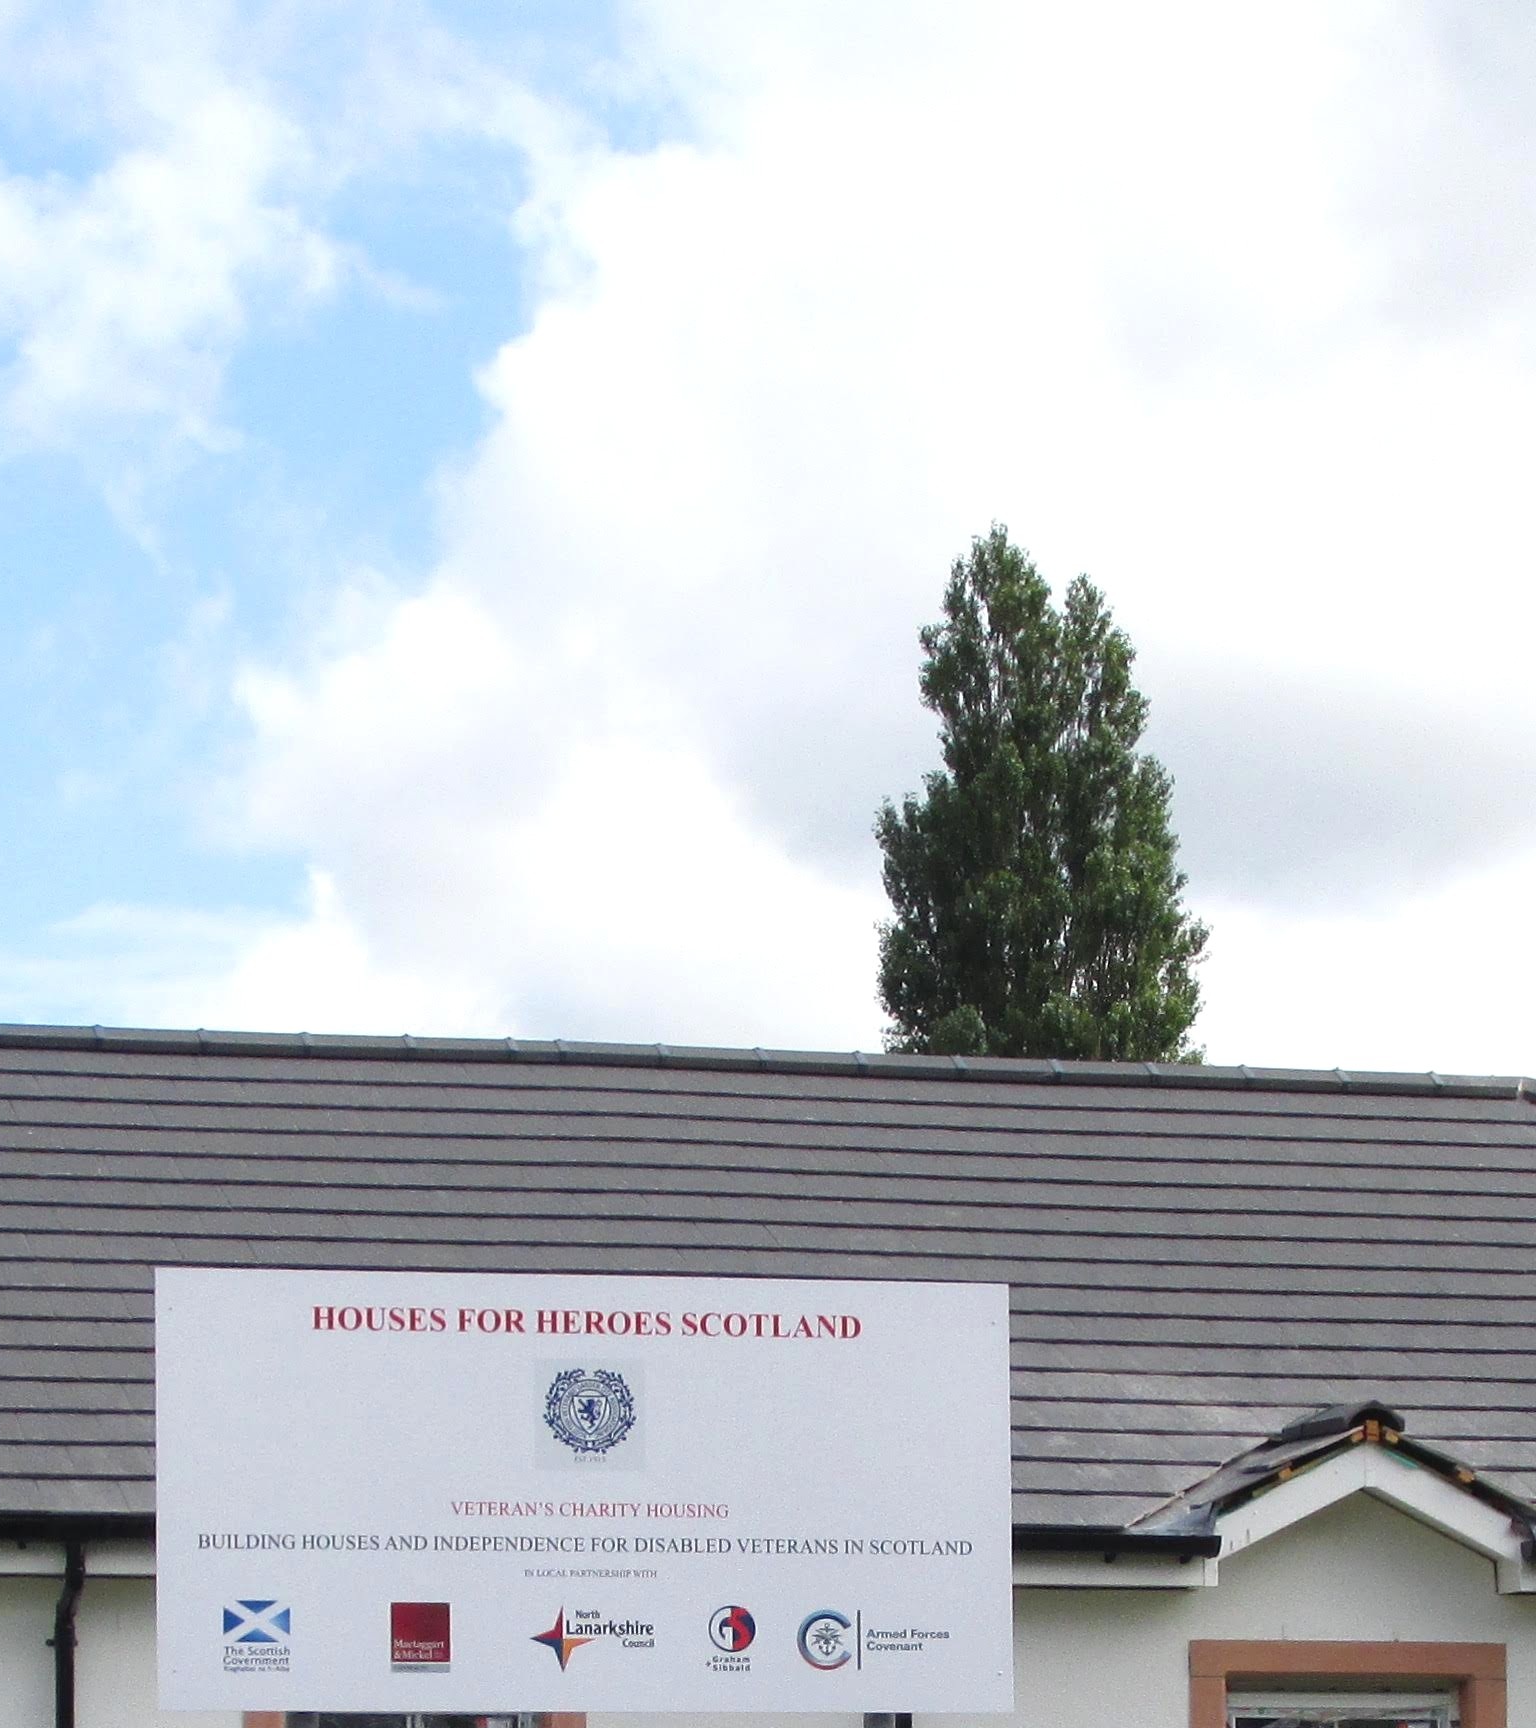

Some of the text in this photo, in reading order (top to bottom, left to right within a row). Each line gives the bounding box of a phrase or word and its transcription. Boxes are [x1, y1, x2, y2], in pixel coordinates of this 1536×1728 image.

[313, 1306, 862, 1339] HOUSES FOR HEROES SCOTLAND
[451, 1501, 729, 1518] VETERAN'S CHARITY HOUSING
[198, 1533, 973, 1556] BUILDING HOUSES AND INDEPENDENCE FOR DISABLED VETERANS IN SCOTLAND
[524, 1569, 657, 1578] IN LOCAL PARTNERSHIP WITH
[575, 1610, 600, 1619] North
[566, 1620, 654, 1638] Lanarkshire
[866, 1629, 950, 1639] Armed Forces
[622, 1638, 655, 1648] Council
[866, 1641, 923, 1651] Covenant
[224, 1646, 291, 1656] The Scottish
[223, 1656, 289, 1666] Government
[712, 1655, 751, 1663] Graham
